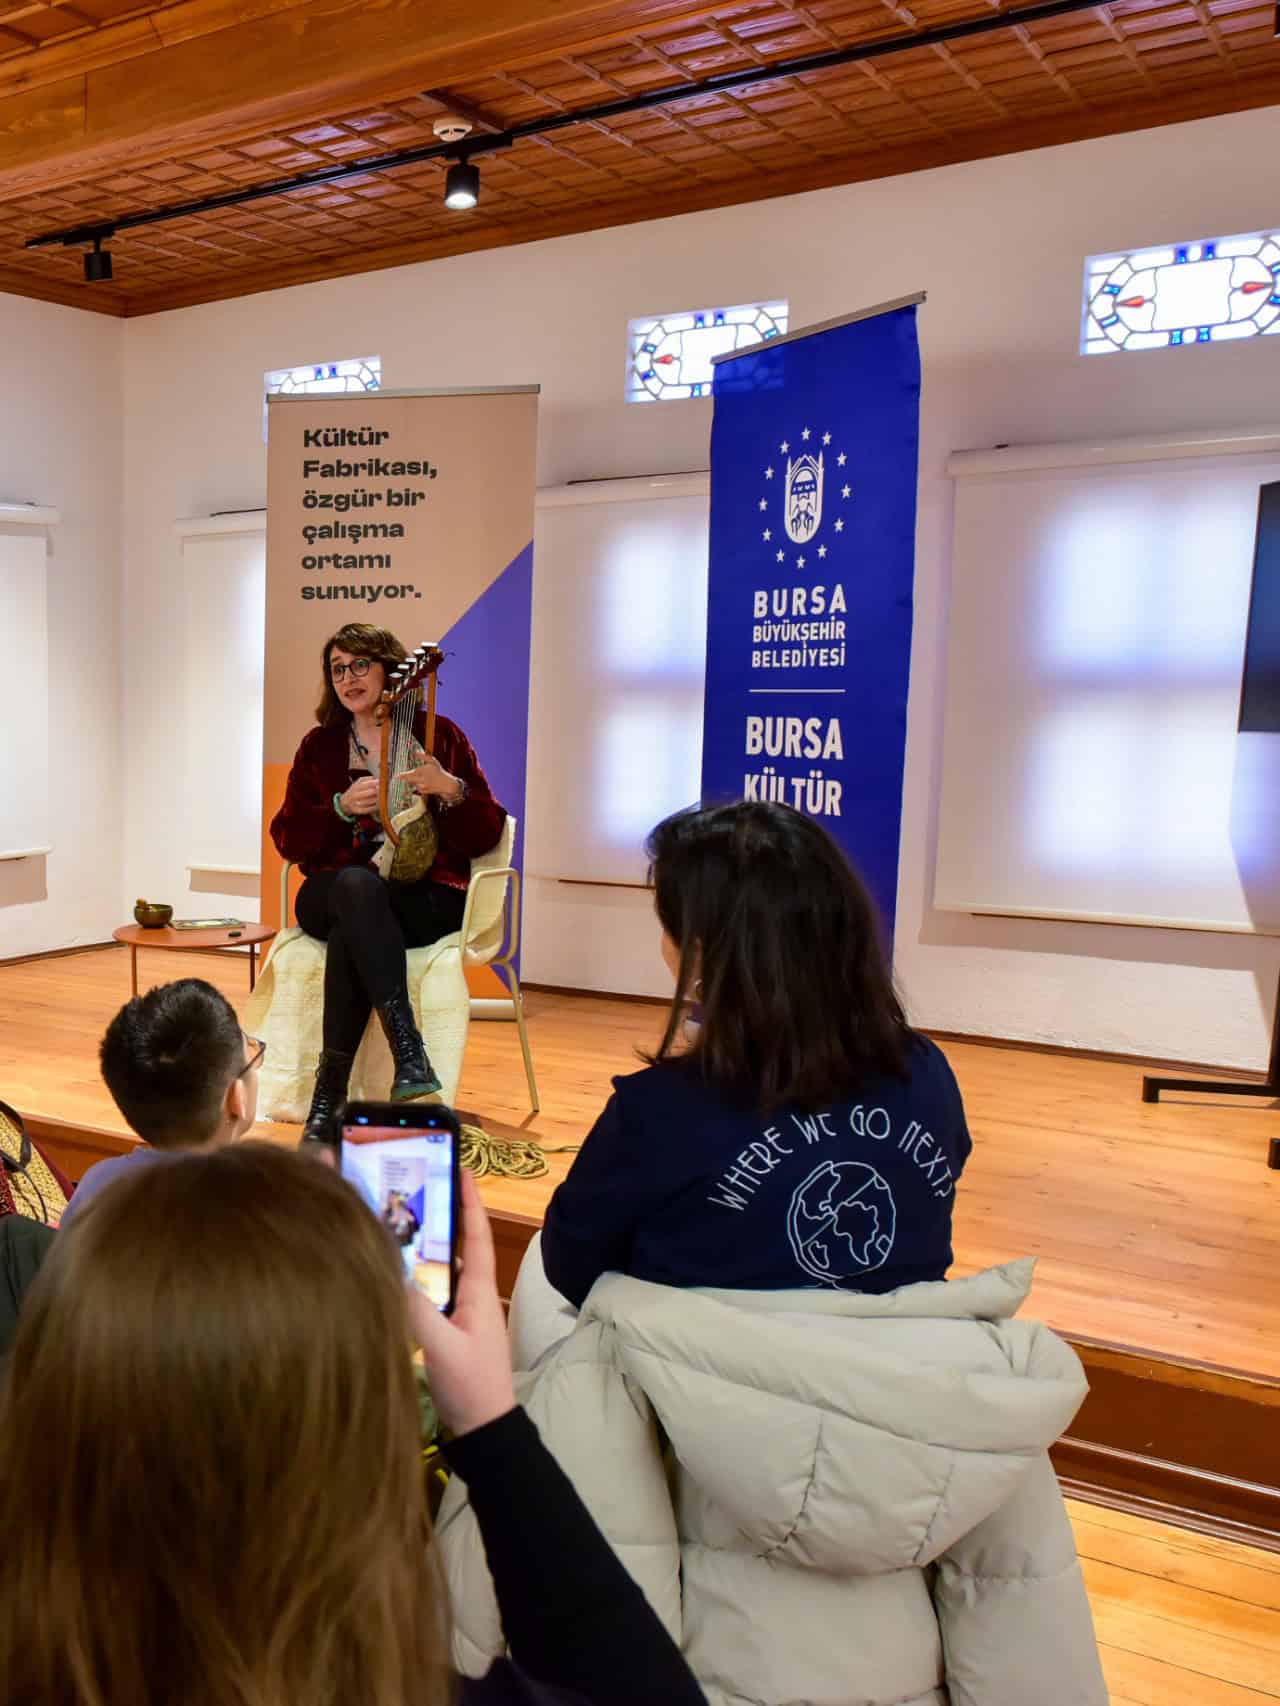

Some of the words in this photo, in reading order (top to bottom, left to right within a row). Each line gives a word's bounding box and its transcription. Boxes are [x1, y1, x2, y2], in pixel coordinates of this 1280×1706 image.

[303, 427, 389, 448] Kültür
[302, 458, 438, 479] Fabrikası,
[302, 490, 382, 512] özgür
[386, 489, 425, 506] bir
[302, 521, 404, 544] çalışma
[301, 553, 391, 569] ortamı
[301, 584, 422, 602] sunuyor.
[753, 583, 847, 618] BURSA
[752, 616, 846, 643] BÜYÜKŞEHİR
[751, 641, 846, 668] BELEDİYESİ
[745, 716, 844, 760] BURSA
[707, 1126, 793, 1212] WHERE
[790, 1113, 837, 1144] WE
[849, 1104, 890, 1140] GO
